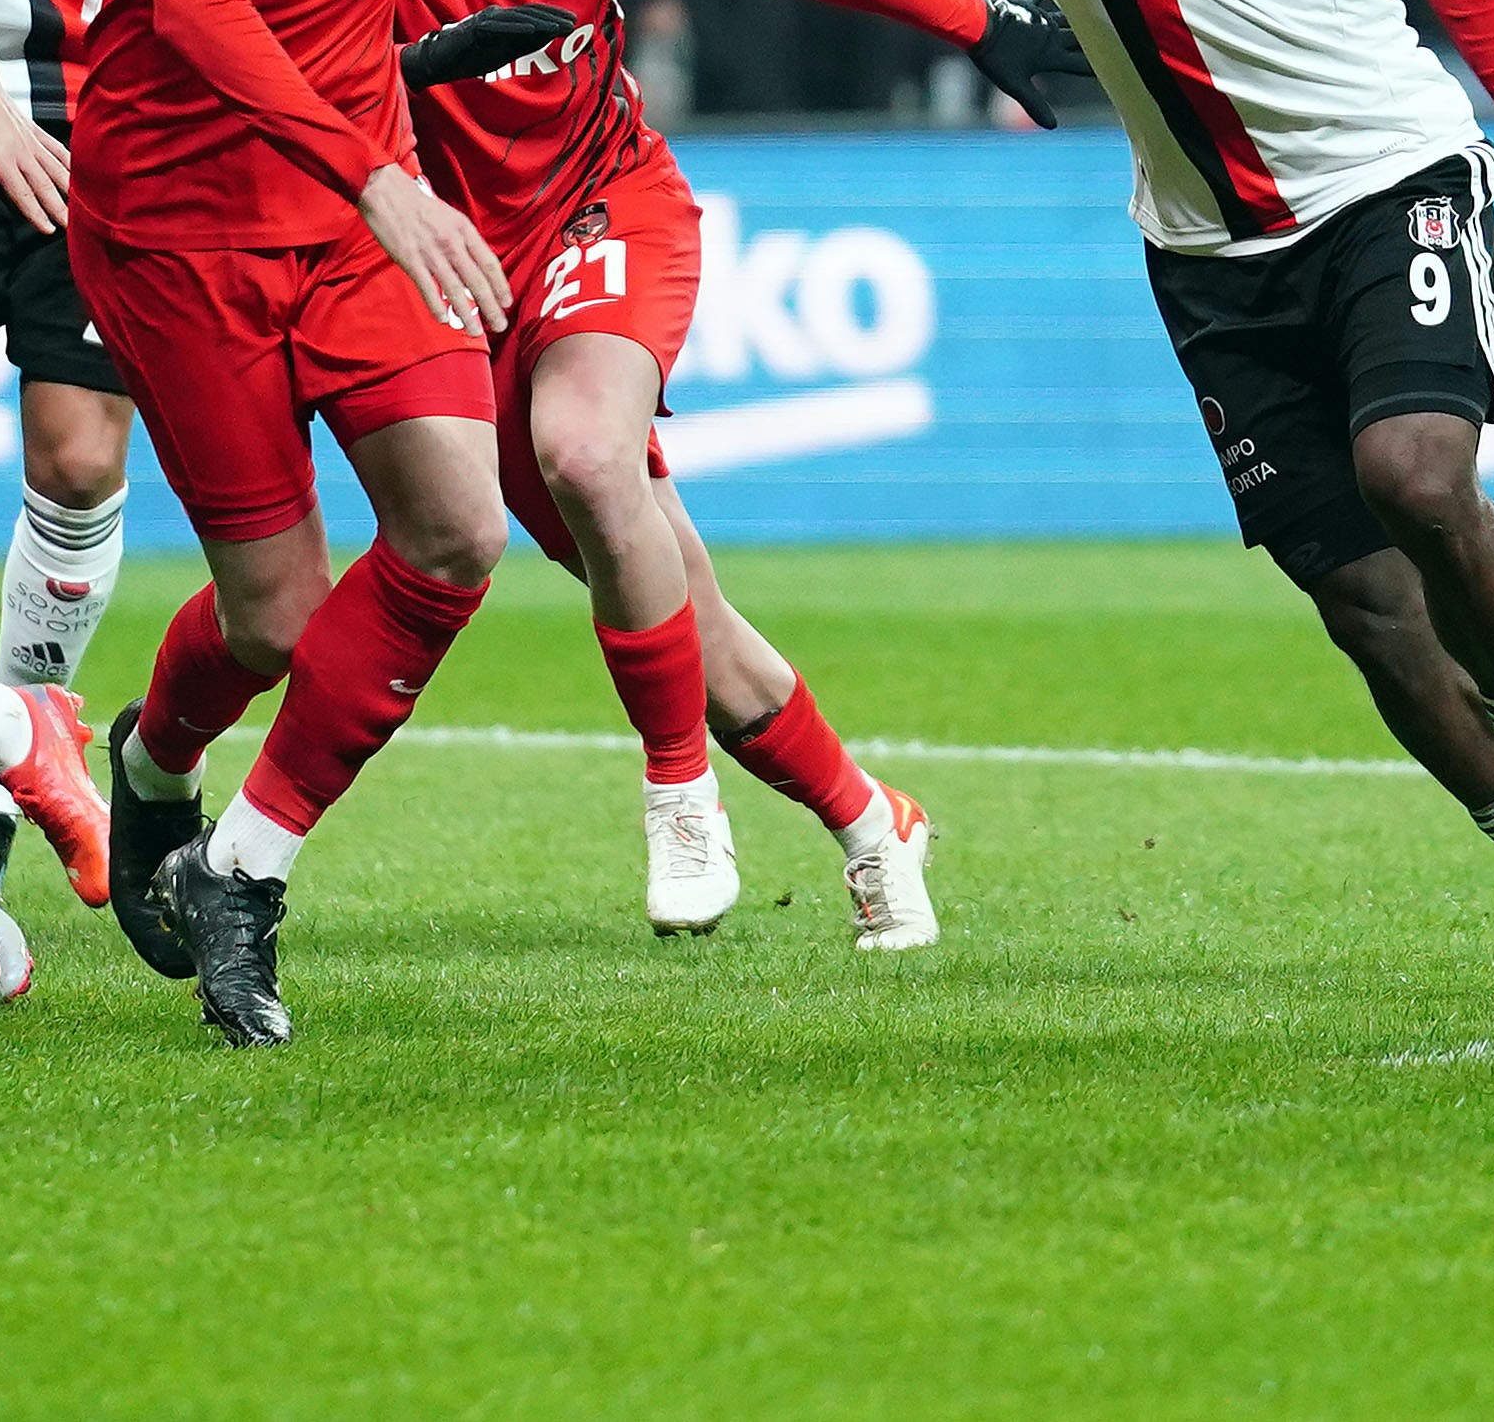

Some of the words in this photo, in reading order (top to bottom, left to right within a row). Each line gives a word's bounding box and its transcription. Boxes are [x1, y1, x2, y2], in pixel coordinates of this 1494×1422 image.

[540, 238, 627, 318] 21
[1409, 251, 1451, 327] 9
[11, 645, 71, 677] adidas
